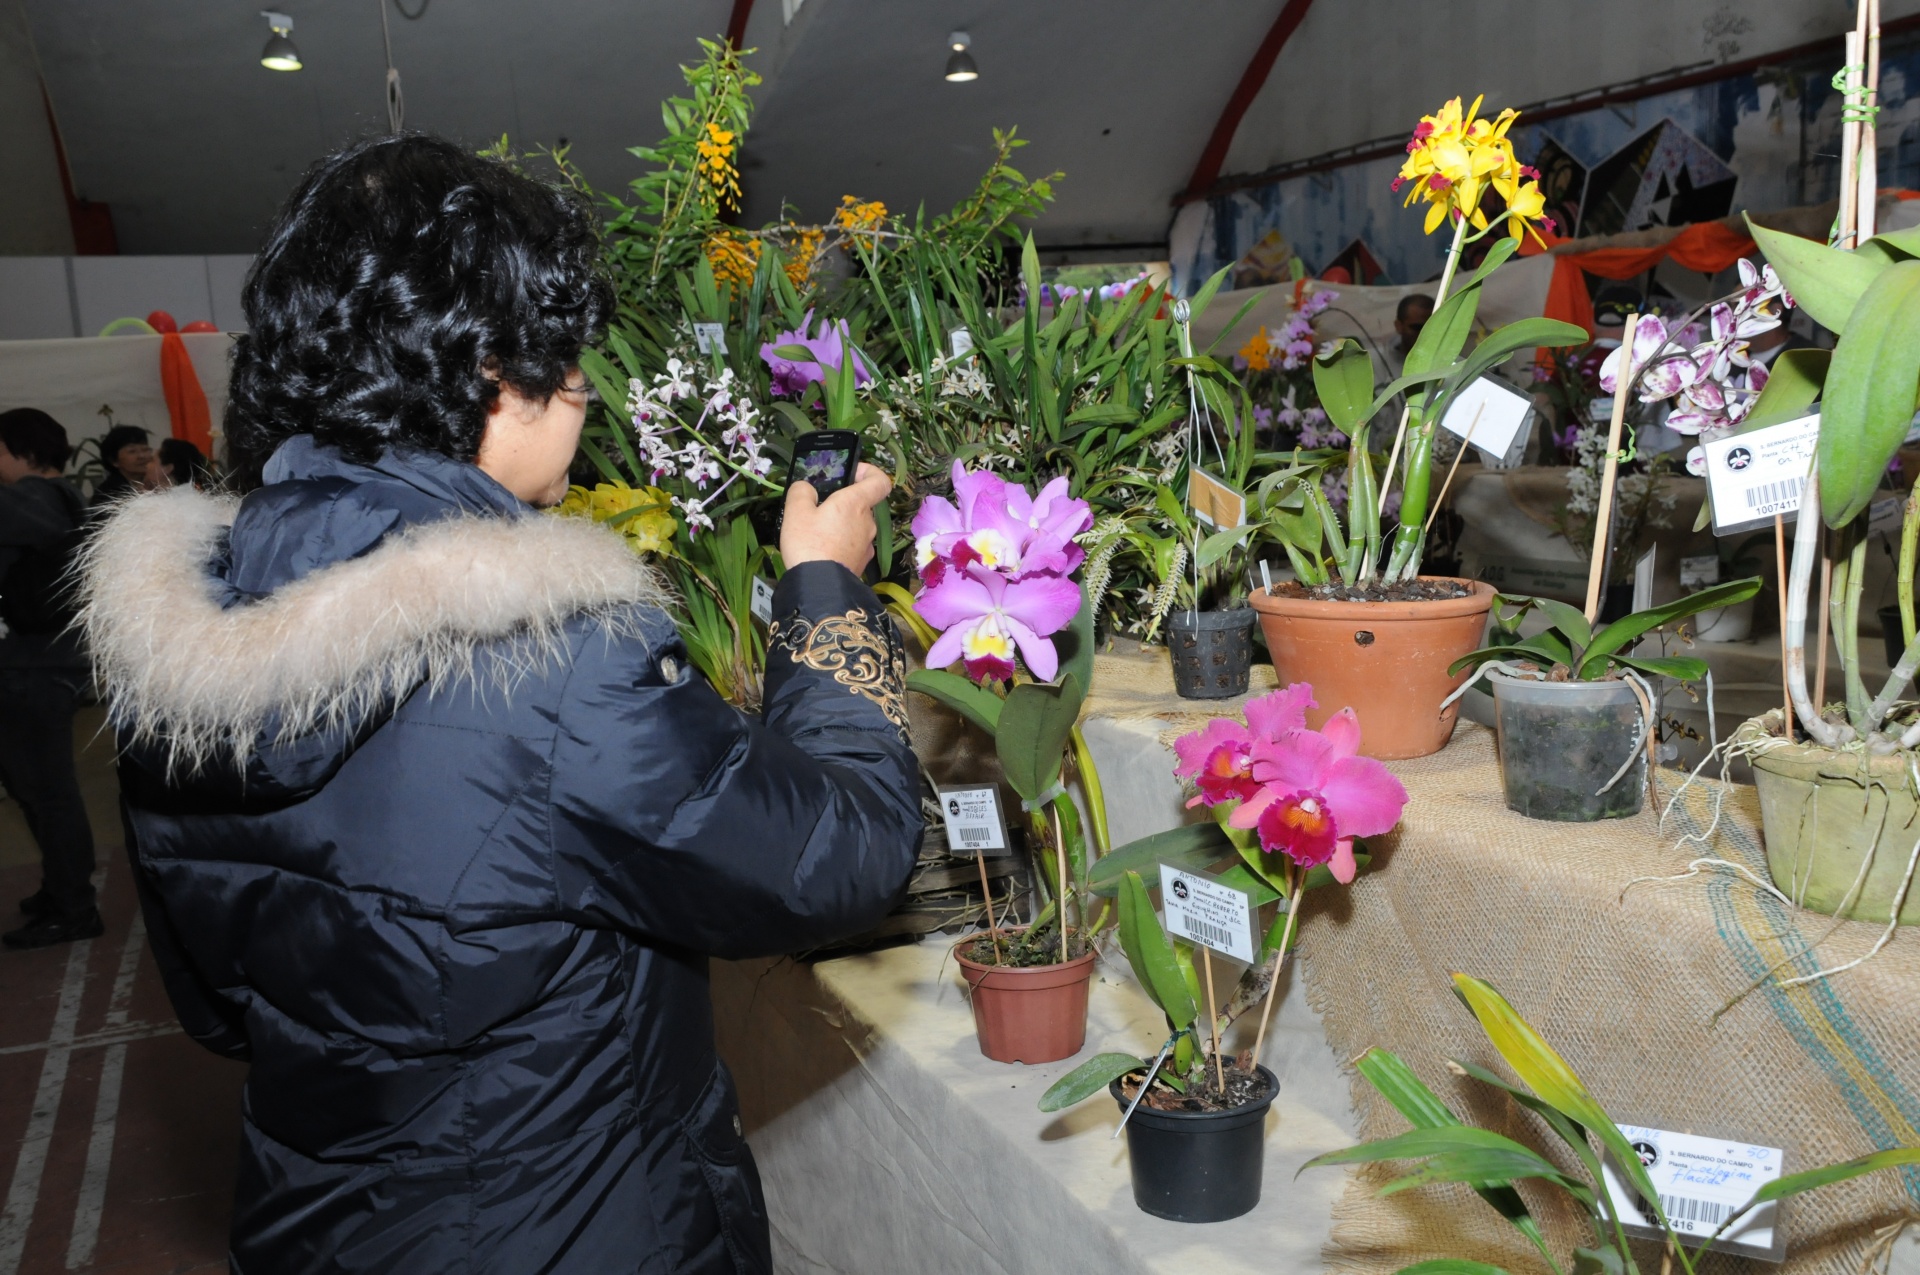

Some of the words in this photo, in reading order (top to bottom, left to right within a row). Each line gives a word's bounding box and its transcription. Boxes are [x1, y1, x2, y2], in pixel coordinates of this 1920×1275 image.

[1766, 436, 1798, 448] BERNARDO
[1756, 499, 1797, 515] 1007411
[1189, 932, 1214, 947] 1007404
[1224, 945, 1229, 953] 1
[1746, 1147, 1770, 1161] 50
[1668, 1160, 1689, 1171] Planta
[1677, 1151, 1716, 1164] BERNARDO
[1717, 1157, 1728, 1166] DO
[1729, 1159, 1754, 1170] CAMPO
[1763, 1165, 1774, 1173] SP
